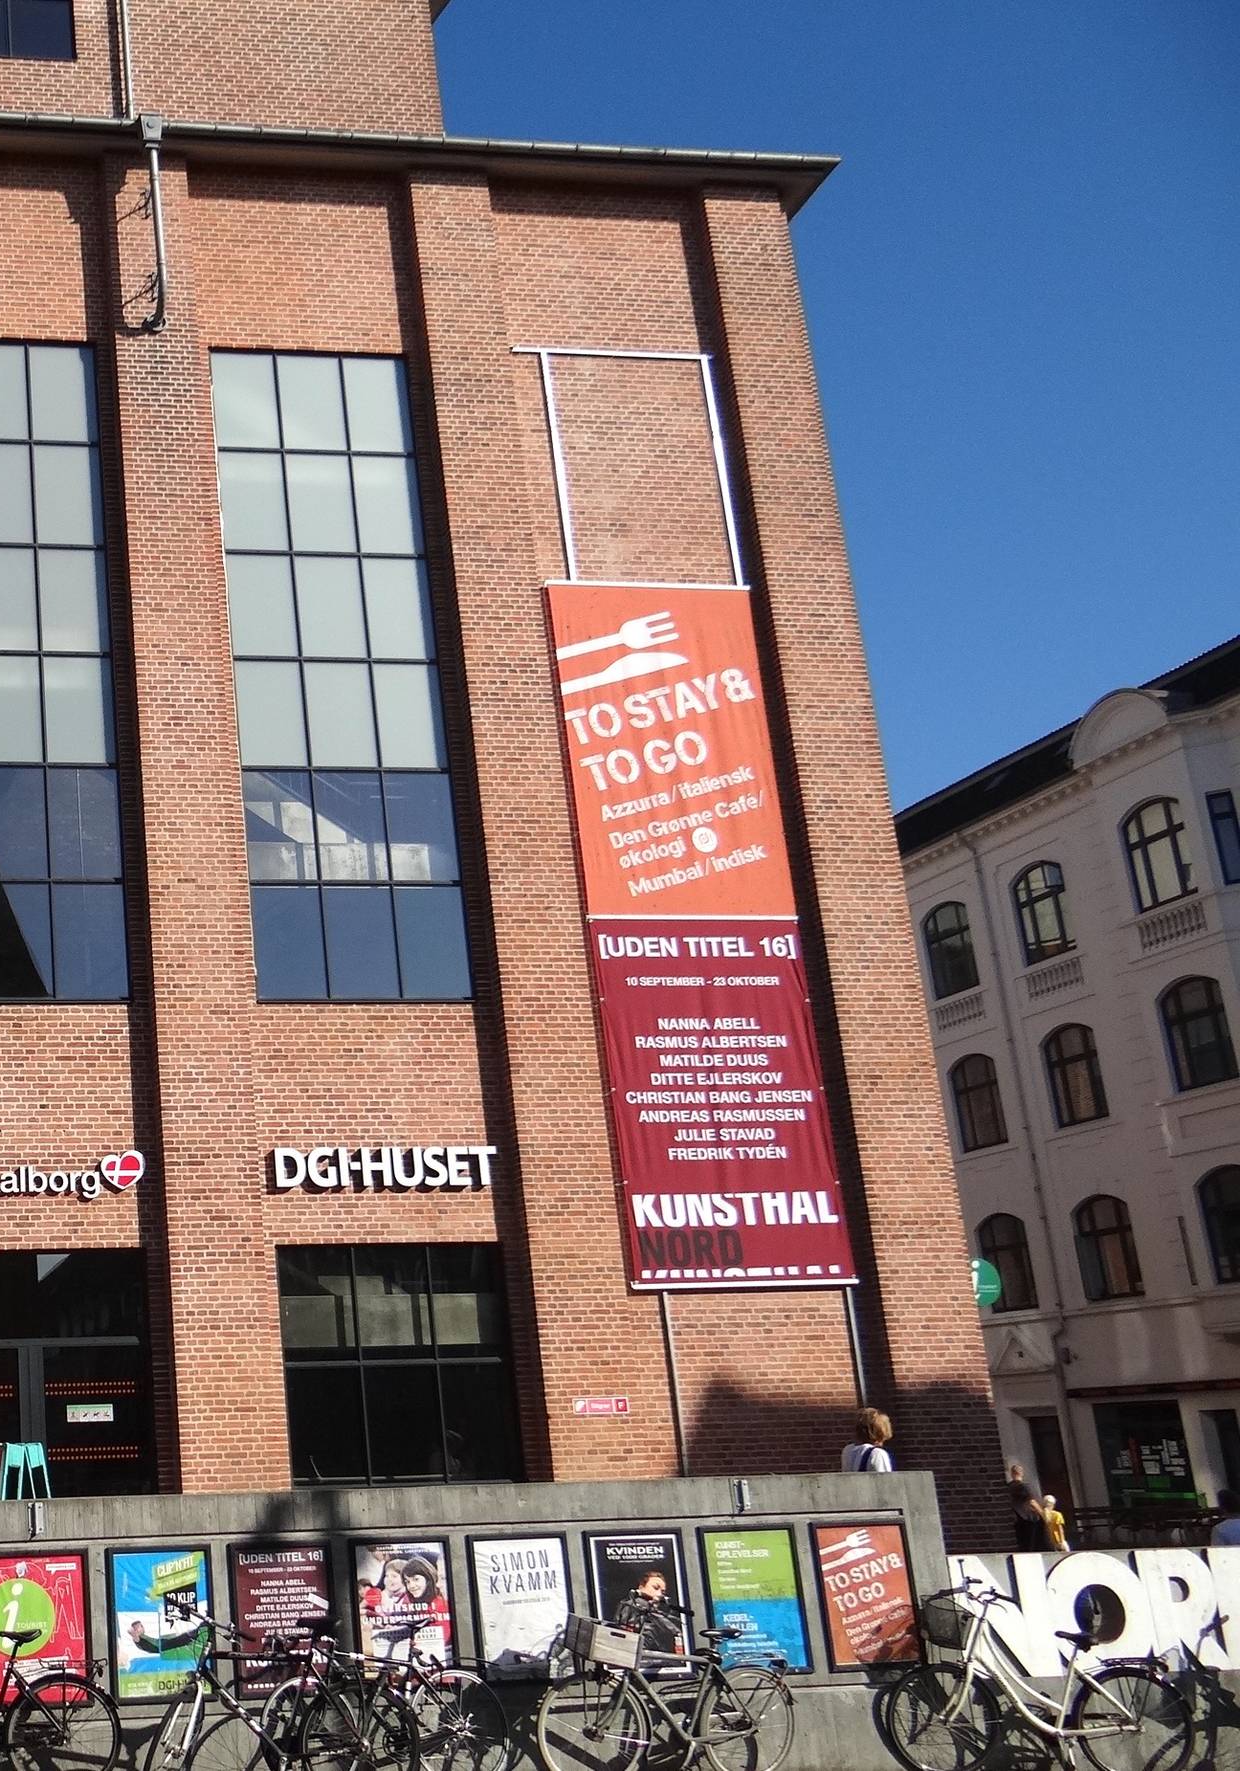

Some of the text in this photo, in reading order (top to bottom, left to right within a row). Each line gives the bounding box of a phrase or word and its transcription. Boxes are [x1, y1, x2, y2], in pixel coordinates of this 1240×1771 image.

[564, 703, 621, 744] TO
[580, 731, 707, 791] TO GO
[609, 830, 647, 849] Den
[648, 810, 713, 837] Grønne
[619, 837, 687, 869] økologi
[684, 936, 754, 958] TITEL
[625, 976, 638, 986] 10
[640, 976, 705, 987] SEPTEMBER
[713, 977, 726, 987] 23
[727, 976, 779, 987] OKTOBER
[658, 1018, 760, 1031] NANNA ABELL
[635, 1036, 787, 1049] RASMUS ALBERTSEN
[660, 1054, 768, 1067] MATILDE DUUS
[651, 1072, 782, 1086] DITTE EJLERSKOV
[626, 1090, 812, 1105] CHRISTIAN BANG JENSEN
[639, 1109, 805, 1123] ANDREAS RASMUSSEN
[674, 1128, 775, 1141] JULIE STAVAD
[668, 1143, 787, 1161] FREDRIK TYDÉN
[274, 1146, 497, 1188] DGI-HUSET
[631, 1190, 839, 1228] KUNSTHAL
[638, 1229, 744, 1267] NORD
[275, 1552, 306, 1562] TITEL
[606, 1546, 664, 1555] KVINDEN
[490, 1549, 549, 1572] SIMON
[490, 1570, 557, 1594] KVAMM
[824, 1573, 849, 1591] TO
[177, 1592, 195, 1603] KLIP
[832, 1582, 885, 1612] TO GO
[301, 1610, 326, 1618] JENSEN
[947, 1548, 1240, 1679] NOR
